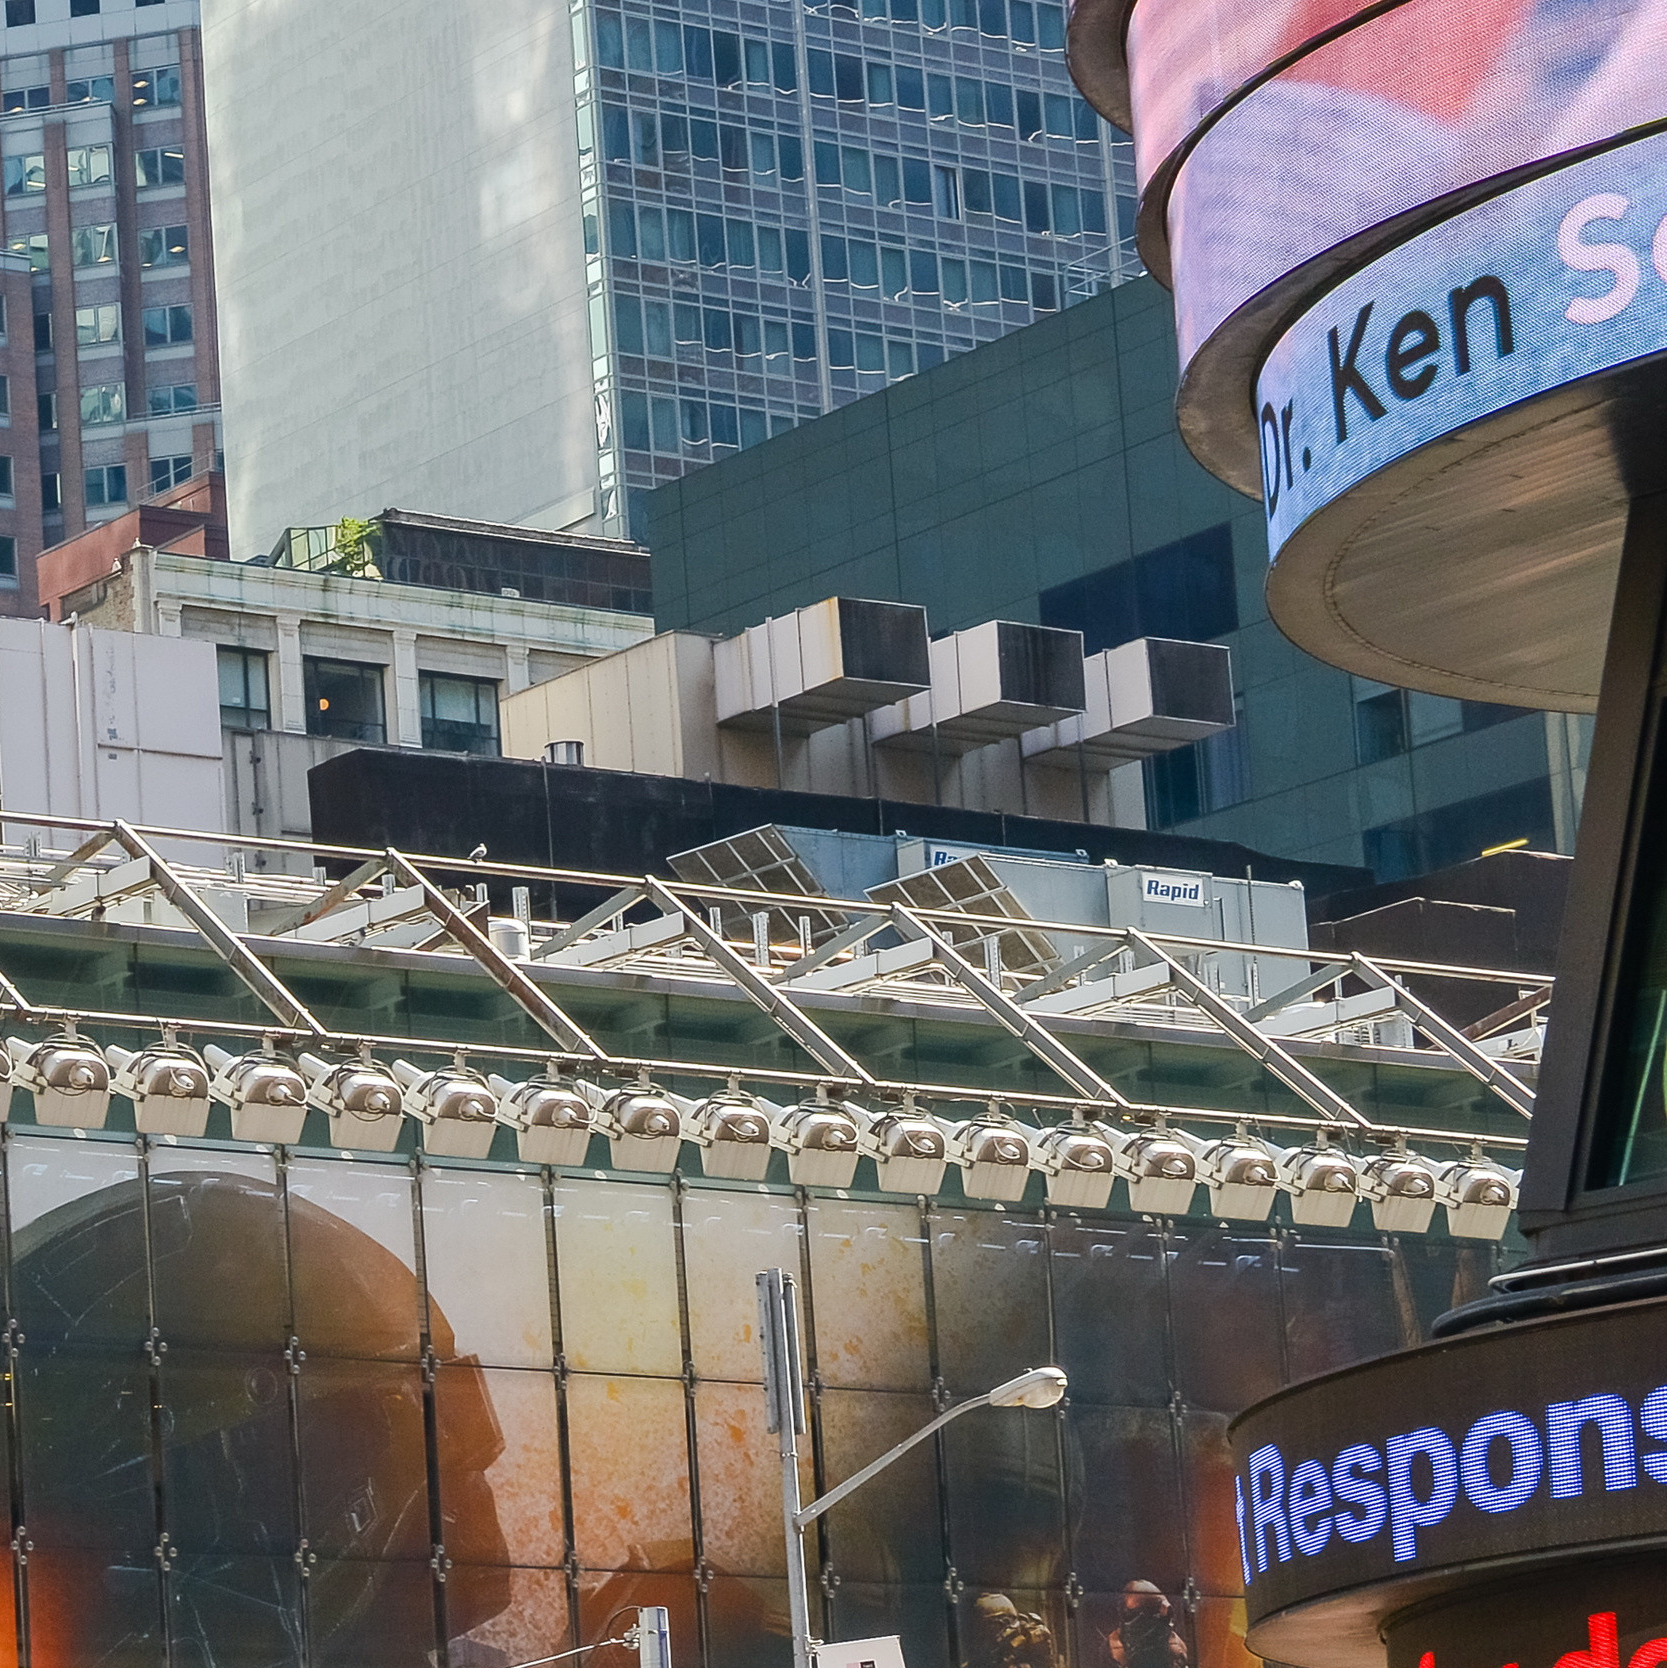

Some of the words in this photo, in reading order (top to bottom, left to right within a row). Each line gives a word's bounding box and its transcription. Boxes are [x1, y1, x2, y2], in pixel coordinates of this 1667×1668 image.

[1327, 274, 1515, 444] Ken
[1556, 191, 1667, 326] S
[1145, 879, 1200, 902] Rapid
